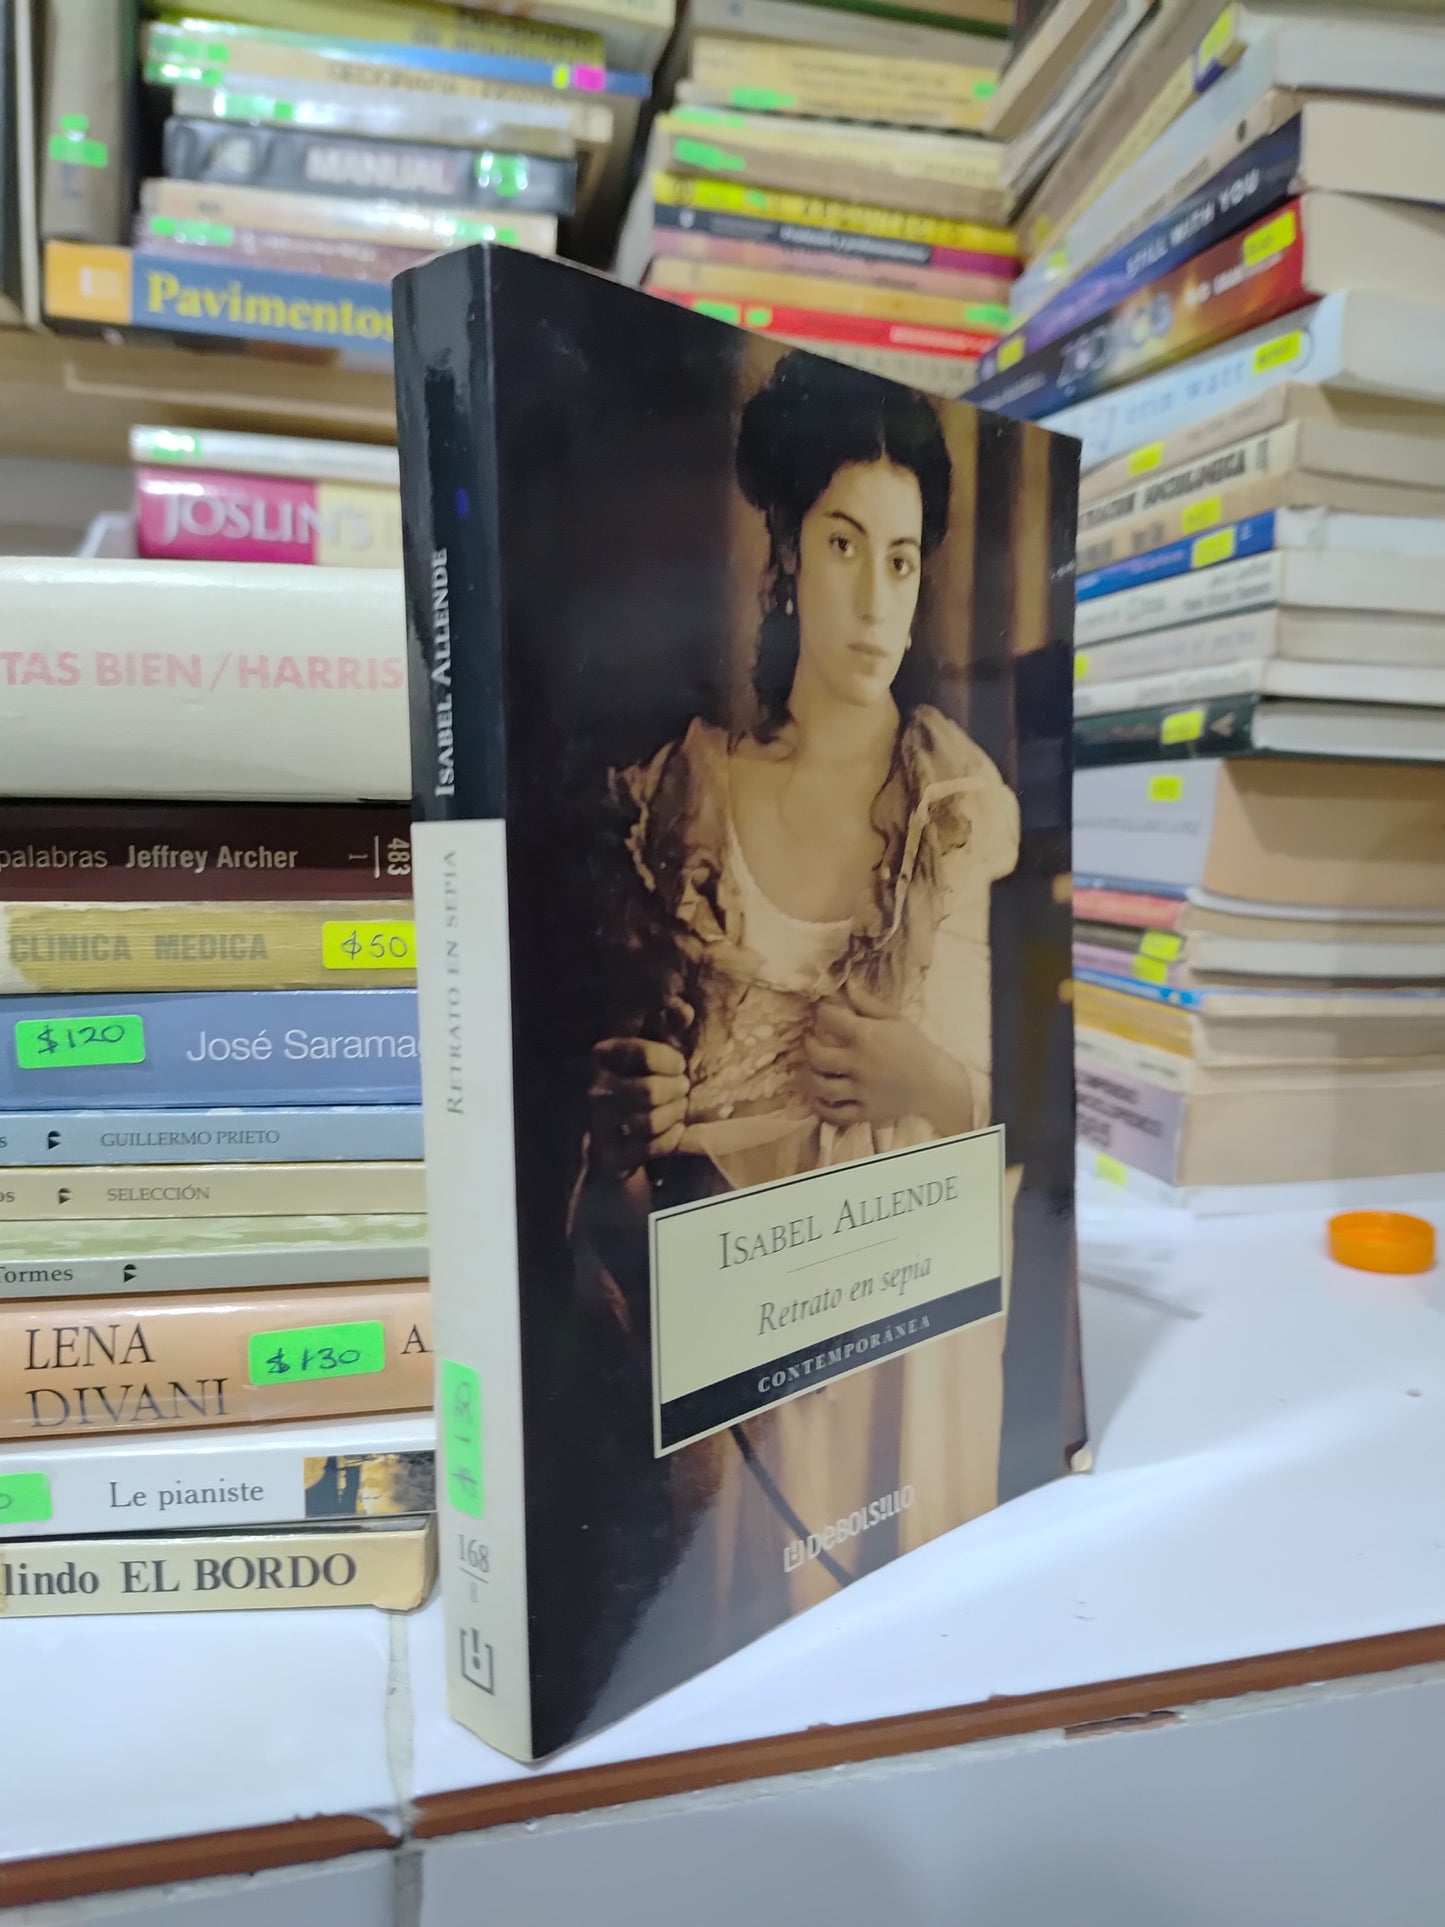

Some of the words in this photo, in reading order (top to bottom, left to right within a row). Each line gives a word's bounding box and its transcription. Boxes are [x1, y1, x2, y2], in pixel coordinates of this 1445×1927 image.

[1171, 201, 1215, 246] WITH
[1218, 168, 1260, 213] YOU
[431, 548, 452, 687] ALLENDE
[1, 652, 81, 686] TAS
[434, 694, 455, 798] ISABEL
[0, 845, 108, 873] palabras
[126, 845, 209, 873] Jeffrey
[216, 845, 299, 869] Archer
[387, 837, 411, 877] 483
[444, 850, 458, 932] SEPIA
[9, 933, 133, 963] CLINICA
[154, 932, 270, 961] MEDICA
[341, 930, 408, 960] $50
[445, 941, 459, 976] EN
[37, 1024, 126, 1055] $120
[186, 1030, 273, 1062] José
[283, 1029, 421, 1060] Sarama
[446, 985, 465, 1116] RETRATO
[101, 1131, 212, 1148] GUILLERMO
[216, 1129, 281, 1146] PRIETO
[107, 1183, 211, 1202] SELECCIÓN
[719, 1213, 823, 1271] ISABEL
[833, 1174, 960, 1235] ALLENDE
[756, 1287, 843, 1337] Retrato
[849, 1277, 874, 1302] en
[879, 1254, 932, 1299] sepia
[23, 1322, 156, 1371] LENA
[400, 1323, 433, 1355] A
[757, 1314, 932, 1394] CONTEMPORÁNEA
[265, 1347, 362, 1376] $130
[26, 1378, 231, 1428] DIVANI
[109, 1481, 147, 1509] Le
[159, 1478, 265, 1511] pianiste
[457, 1532, 491, 1574] 168
[3, 1561, 99, 1596] lindo
[120, 1558, 181, 1594] EL
[193, 1551, 357, 1592] BORDO
